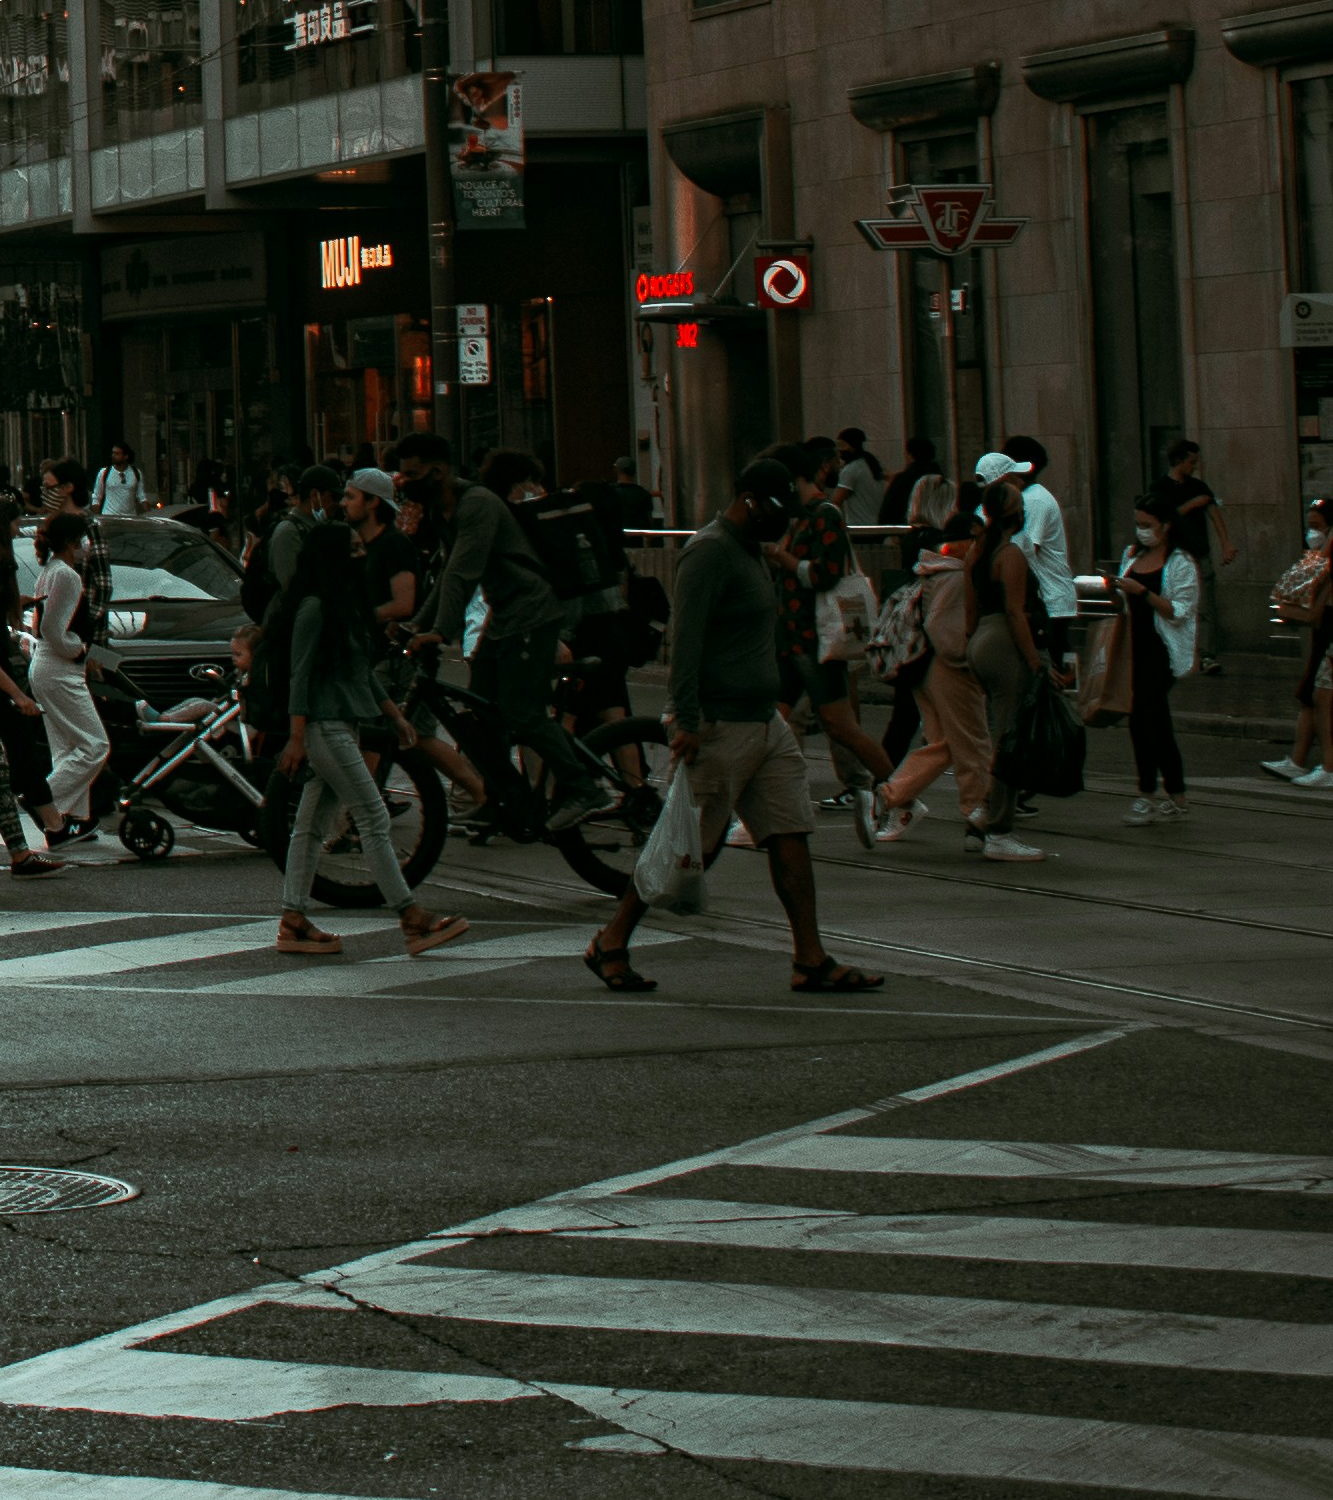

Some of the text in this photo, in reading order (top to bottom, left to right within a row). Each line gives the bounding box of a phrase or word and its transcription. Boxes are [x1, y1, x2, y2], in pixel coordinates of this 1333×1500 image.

[456, 180, 496, 190] INDULGE
[463, 188, 516, 199] TORONTO'S
[477, 198, 524, 207] CULTURAL
[472, 207, 502, 217] HEART
[320, 235, 361, 288] MUJI
[649, 272, 694, 298] ROGERS
[676, 323, 698, 347] 302
